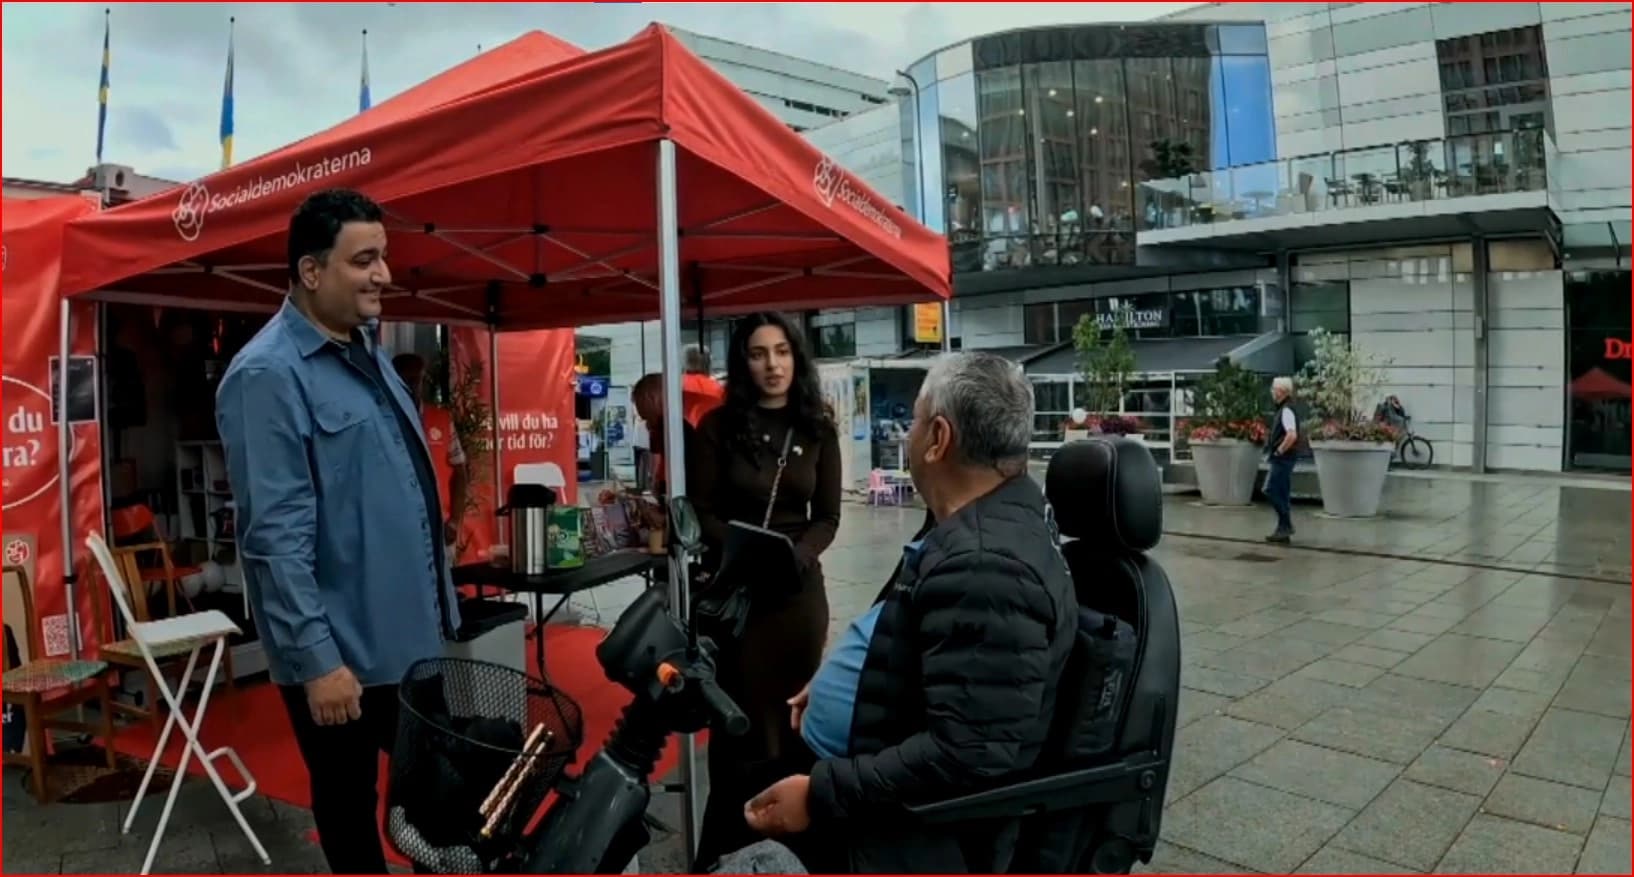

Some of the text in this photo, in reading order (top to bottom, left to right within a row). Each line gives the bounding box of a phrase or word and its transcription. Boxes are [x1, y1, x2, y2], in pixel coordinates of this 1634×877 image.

[208, 147, 372, 214] Socialdemokraterna
[1096, 309, 1162, 323] HAILTON
[8, 405, 43, 433] du
[499, 413, 519, 430] vill
[522, 413, 540, 430] du
[542, 412, 558, 430] ha
[507, 432, 526, 450] tid
[529, 431, 553, 449] för?
